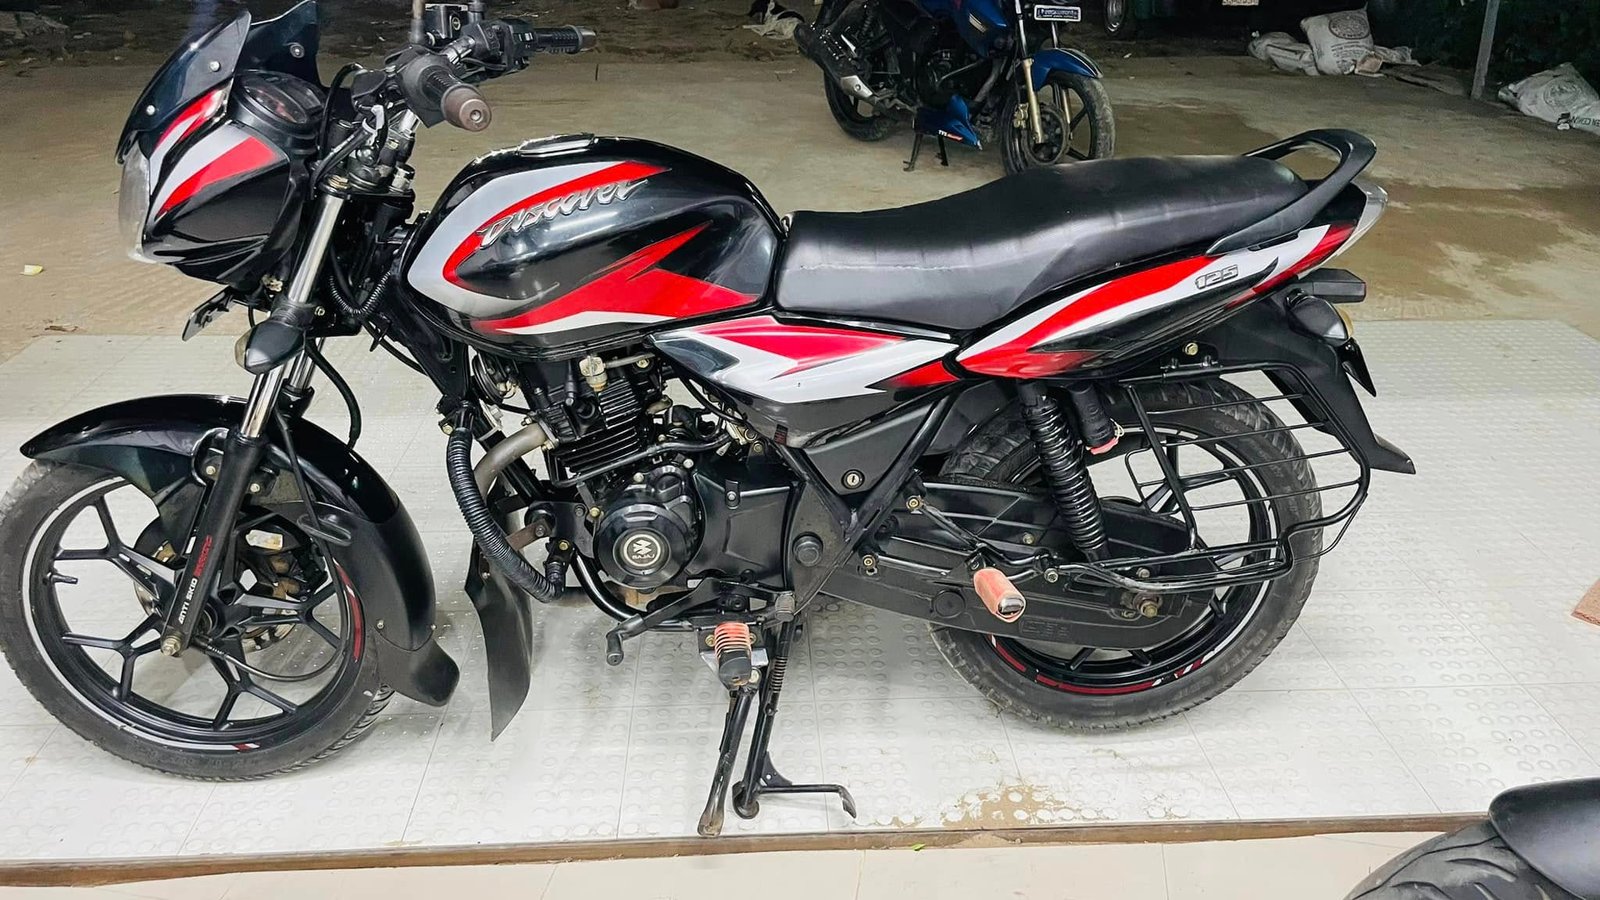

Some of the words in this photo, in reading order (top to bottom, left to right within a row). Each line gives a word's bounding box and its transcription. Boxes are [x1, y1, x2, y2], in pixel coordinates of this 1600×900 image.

[1195, 264, 1238, 290] 125
[178, 601, 189, 625] ANTI
[185, 577, 198, 600] SKID
